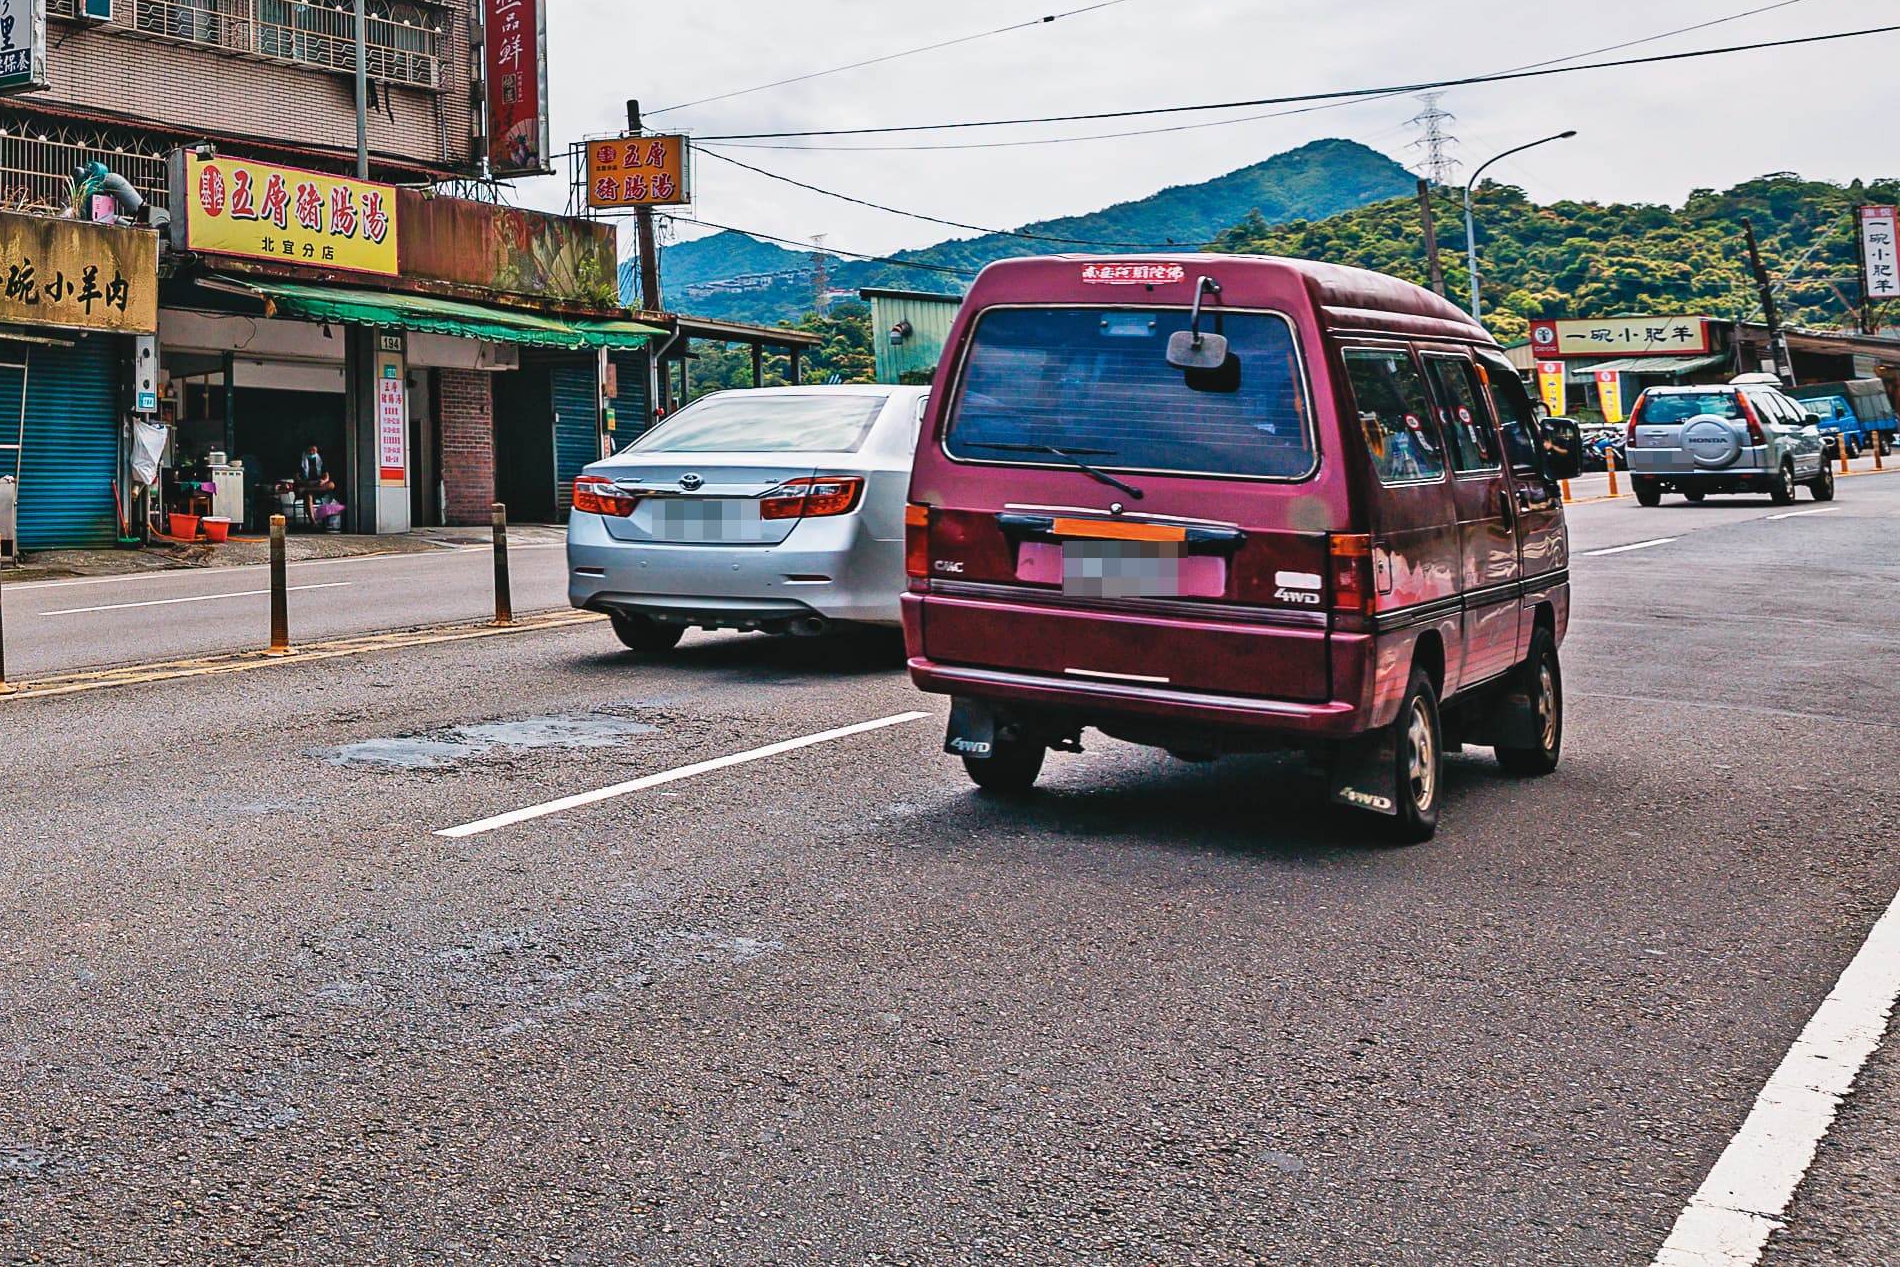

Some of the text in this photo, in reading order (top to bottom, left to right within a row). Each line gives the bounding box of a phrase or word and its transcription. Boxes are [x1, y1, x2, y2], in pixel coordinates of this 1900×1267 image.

[229, 167, 391, 244] 五層豬腸湯
[261, 236, 334, 261] 北宜分店
[1565, 325, 1695, 344] 一碗小肥羊
[1273, 587, 1321, 604] 4WD
[949, 737, 991, 753] 4WD
[1339, 786, 1392, 809] 4WD
